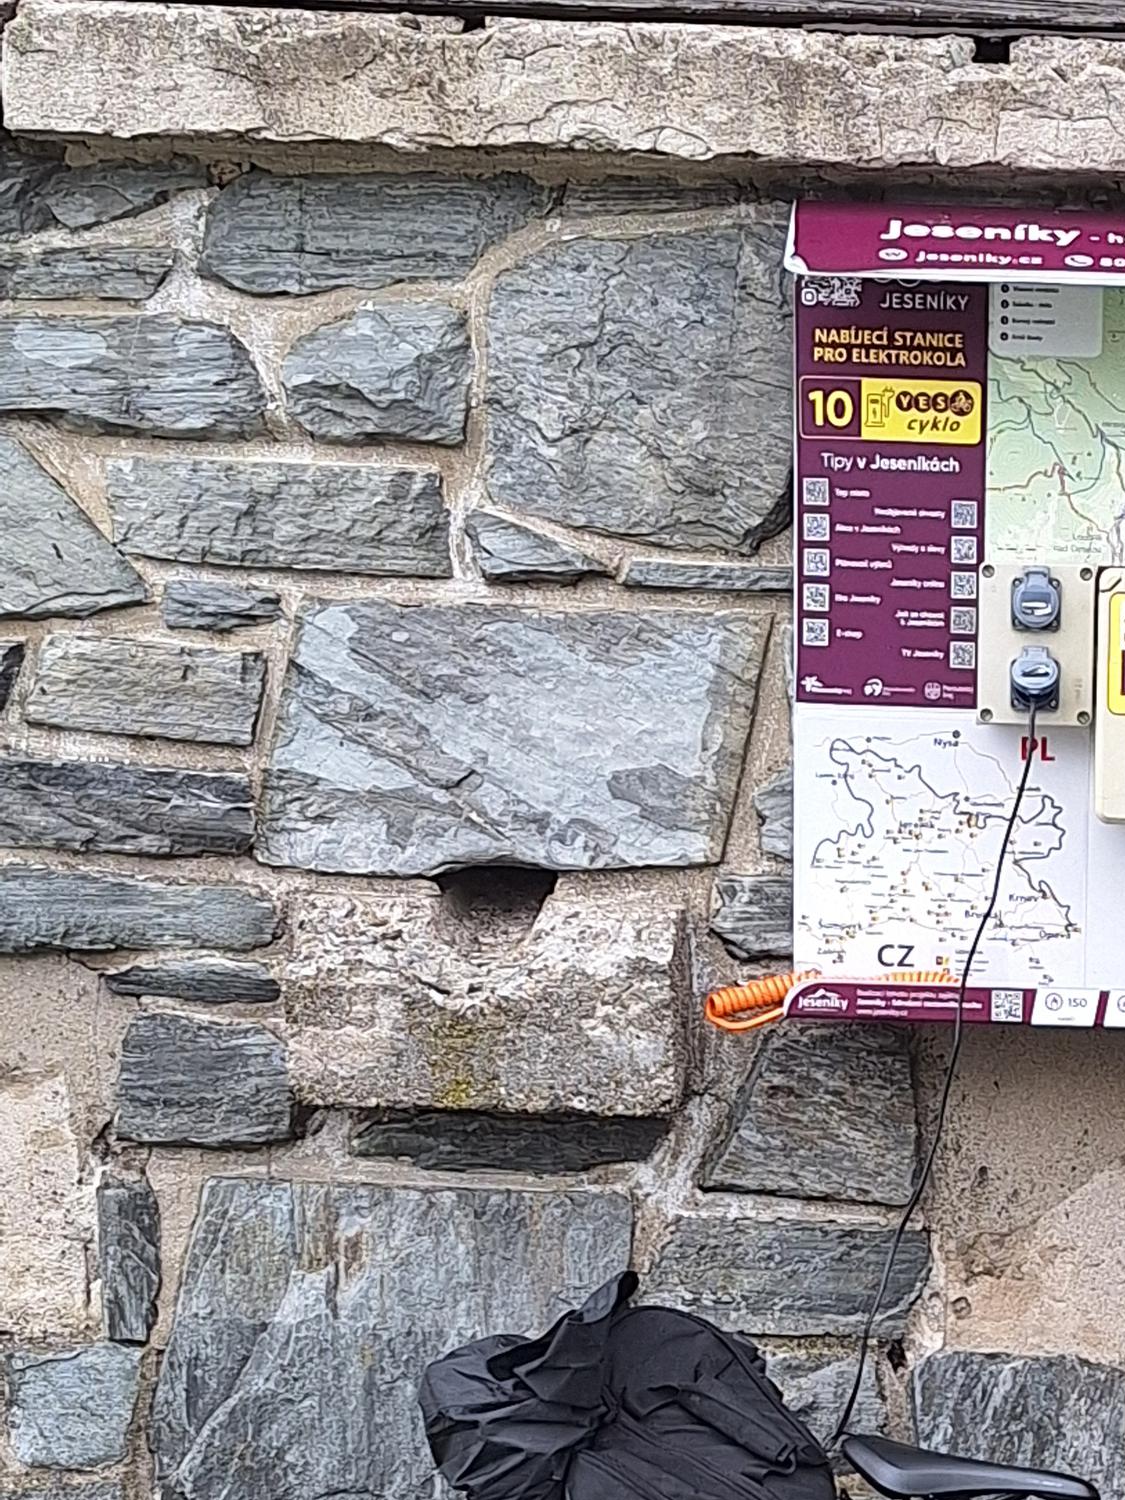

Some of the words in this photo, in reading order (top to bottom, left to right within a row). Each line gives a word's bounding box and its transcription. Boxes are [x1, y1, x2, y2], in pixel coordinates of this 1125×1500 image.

[880, 219, 1081, 247] Jeseníky
[880, 290, 969, 311] JESENÍKY
[814, 325, 889, 346] NABÍJECÍ
[893, 331, 964, 348] STANICE
[813, 347, 848, 363] PRO
[851, 348, 967, 368] ELEKTROKOLA
[807, 389, 854, 428] 10
[906, 415, 961, 434] cyklo
[820, 452, 853, 472] Tipy
[856, 456, 867, 469] v
[870, 453, 961, 473] Jeseníkách
[1021, 736, 1056, 761] PL
[877, 943, 916, 968] CZ
[1067, 997, 1088, 1008] 150
